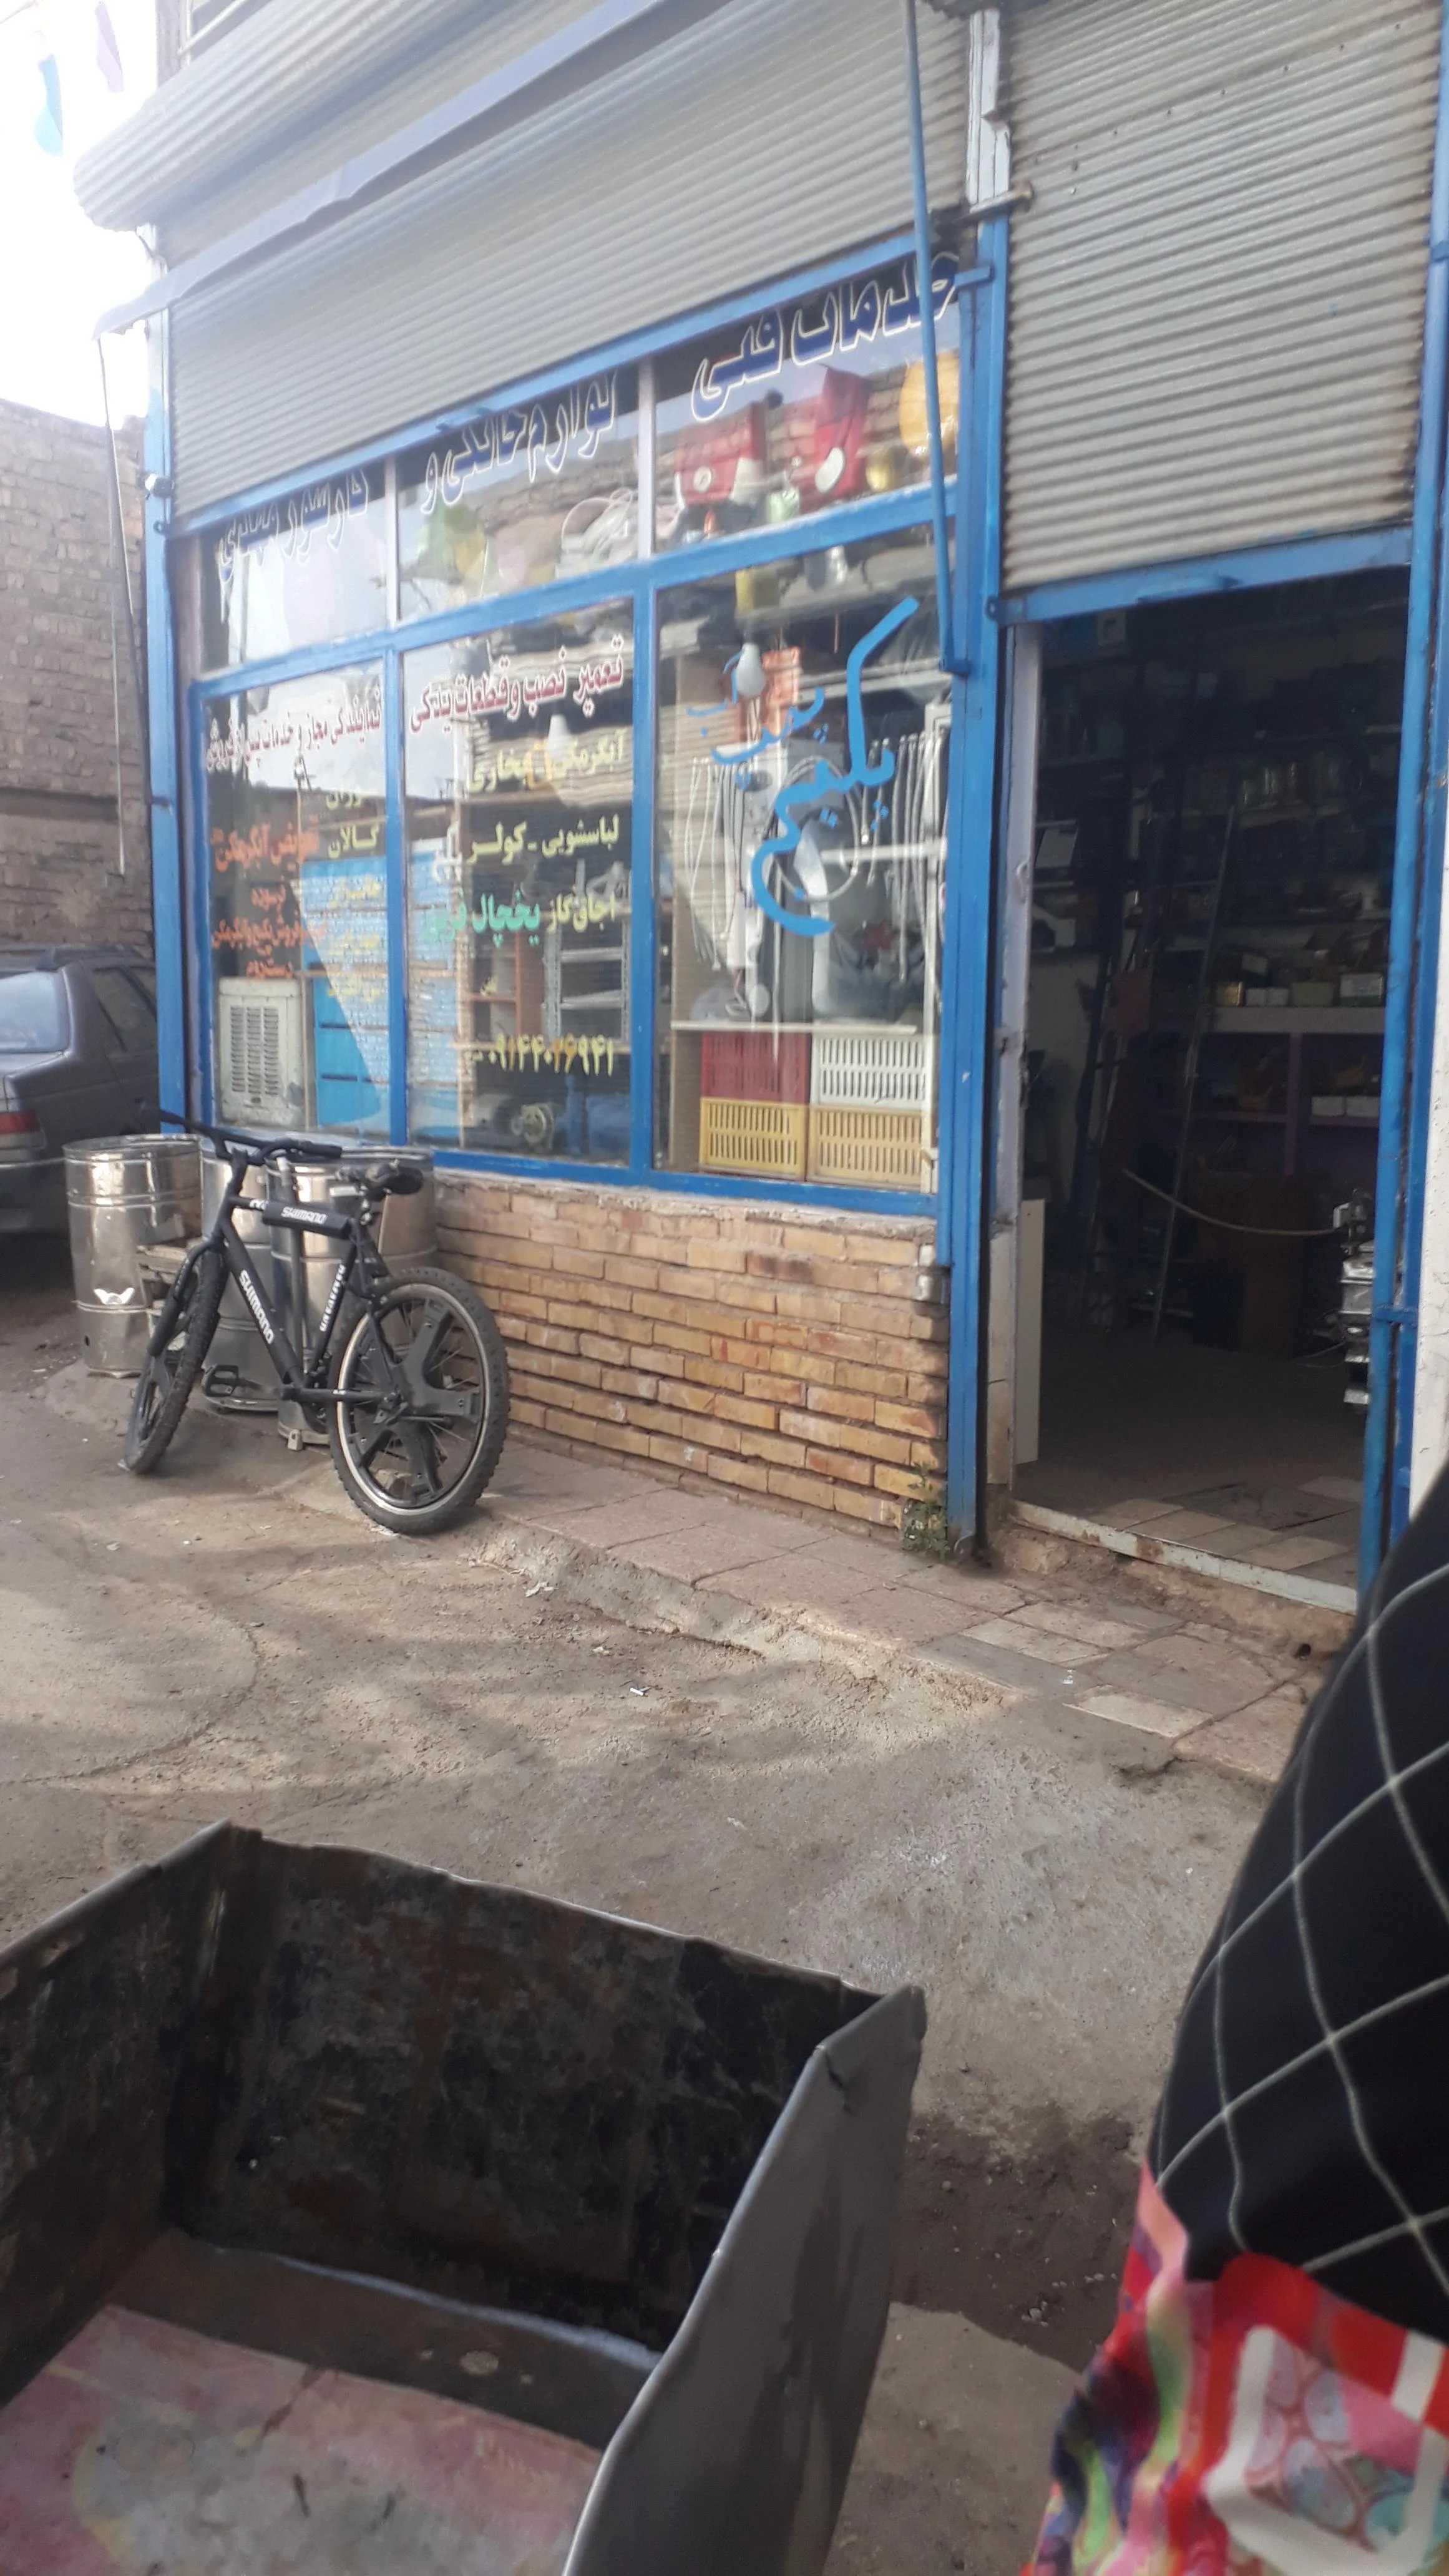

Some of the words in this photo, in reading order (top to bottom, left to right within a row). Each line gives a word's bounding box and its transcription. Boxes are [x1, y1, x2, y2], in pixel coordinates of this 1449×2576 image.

[523, 645, 568, 717] نصب
[573, 634, 624, 717] تعمیر
[410, 683, 454, 734] یدکی
[541, 812, 620, 859] لباسشویی
[471, 889, 542, 948] یخچال
[239, 1269, 275, 1345] SHIMANO
